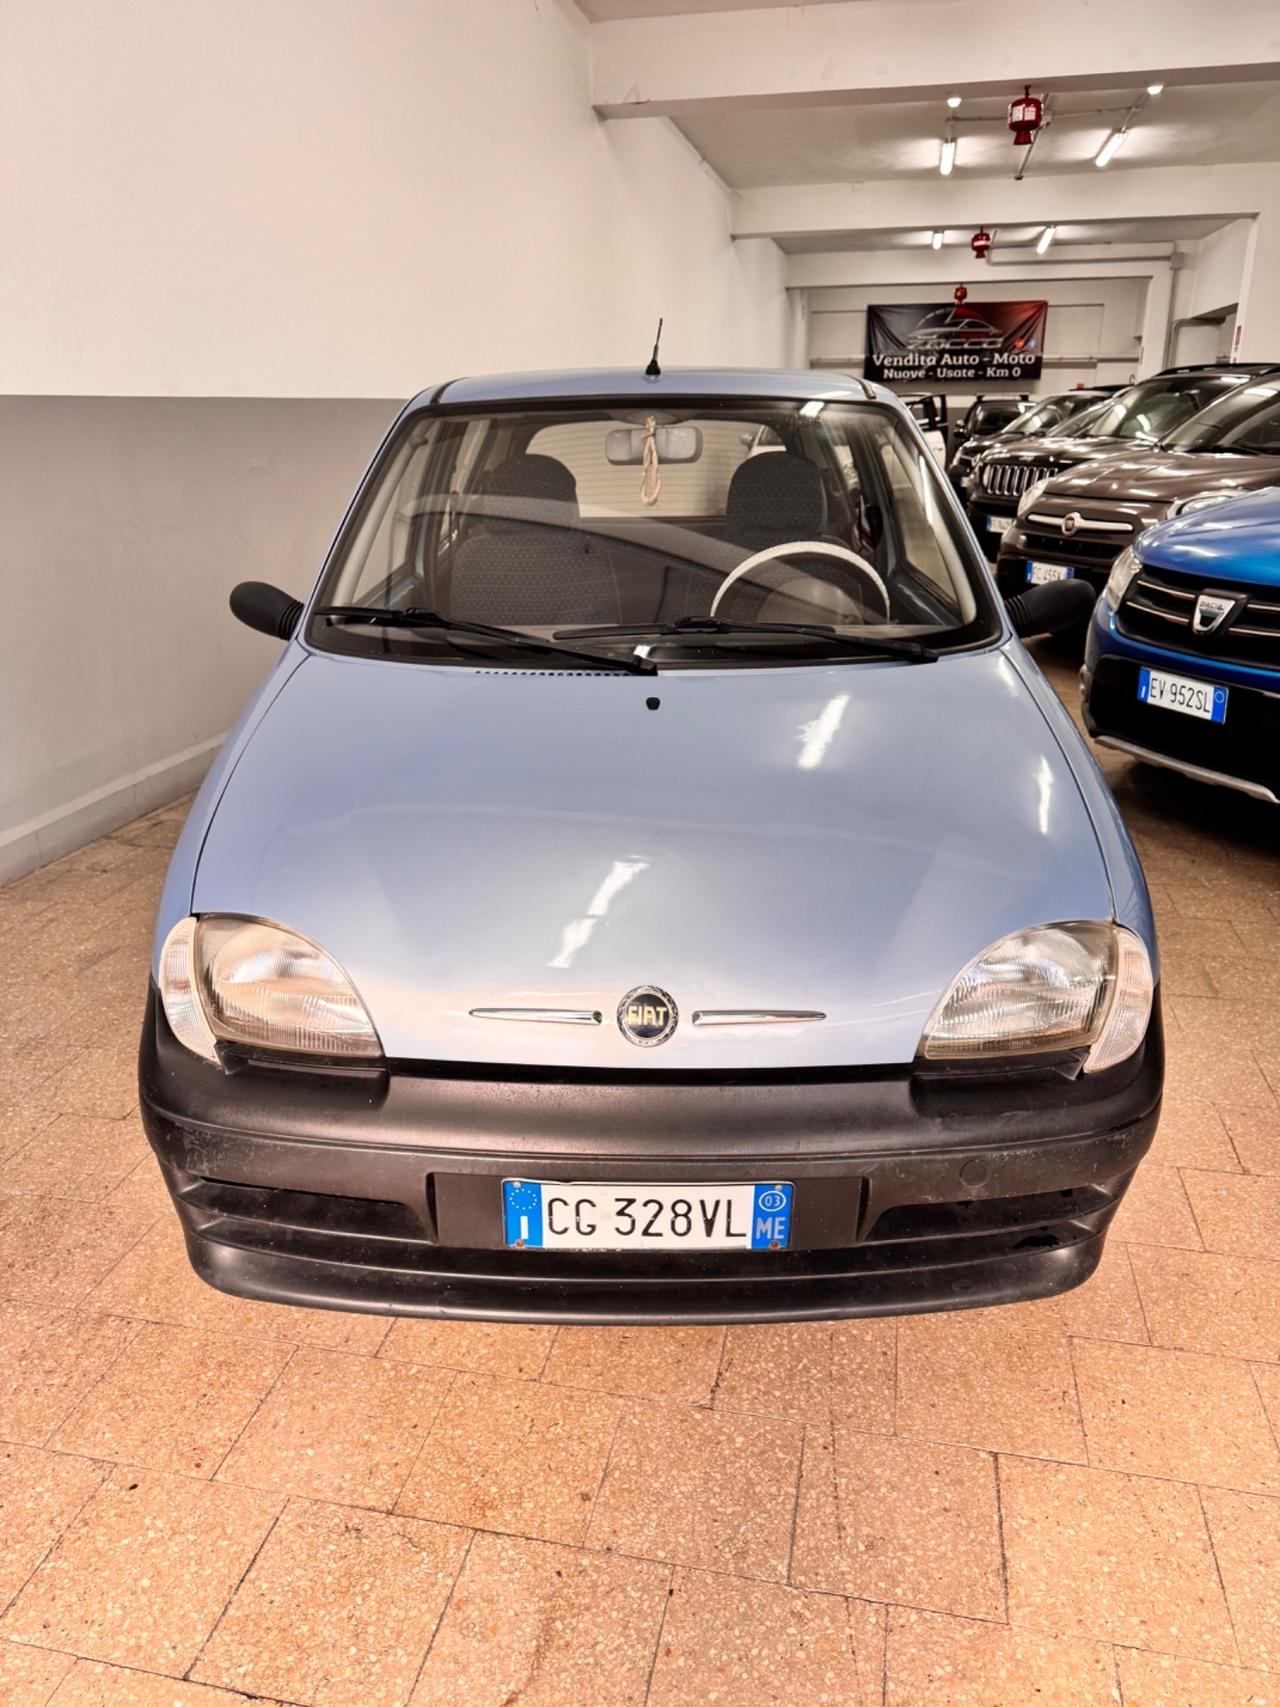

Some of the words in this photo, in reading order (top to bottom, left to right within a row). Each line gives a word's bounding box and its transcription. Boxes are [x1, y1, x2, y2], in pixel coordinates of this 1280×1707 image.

[873, 354, 937, 366] Vendita
[941, 353, 979, 365] Auto
[993, 353, 1036, 365] Moto
[883, 368, 925, 379] Nuove
[937, 367, 975, 378] Usate
[987, 367, 1009, 378] Km
[1012, 367, 1021, 378] 0
[1150, 678, 1166, 699] EV
[1170, 683, 1210, 713] 952SL
[627, 1005, 667, 1026] FIAT
[765, 1195, 781, 1207] 03
[548, 1198, 597, 1235] CG
[614, 1198, 747, 1238] 328VL
[756, 1217, 786, 1240] ME
